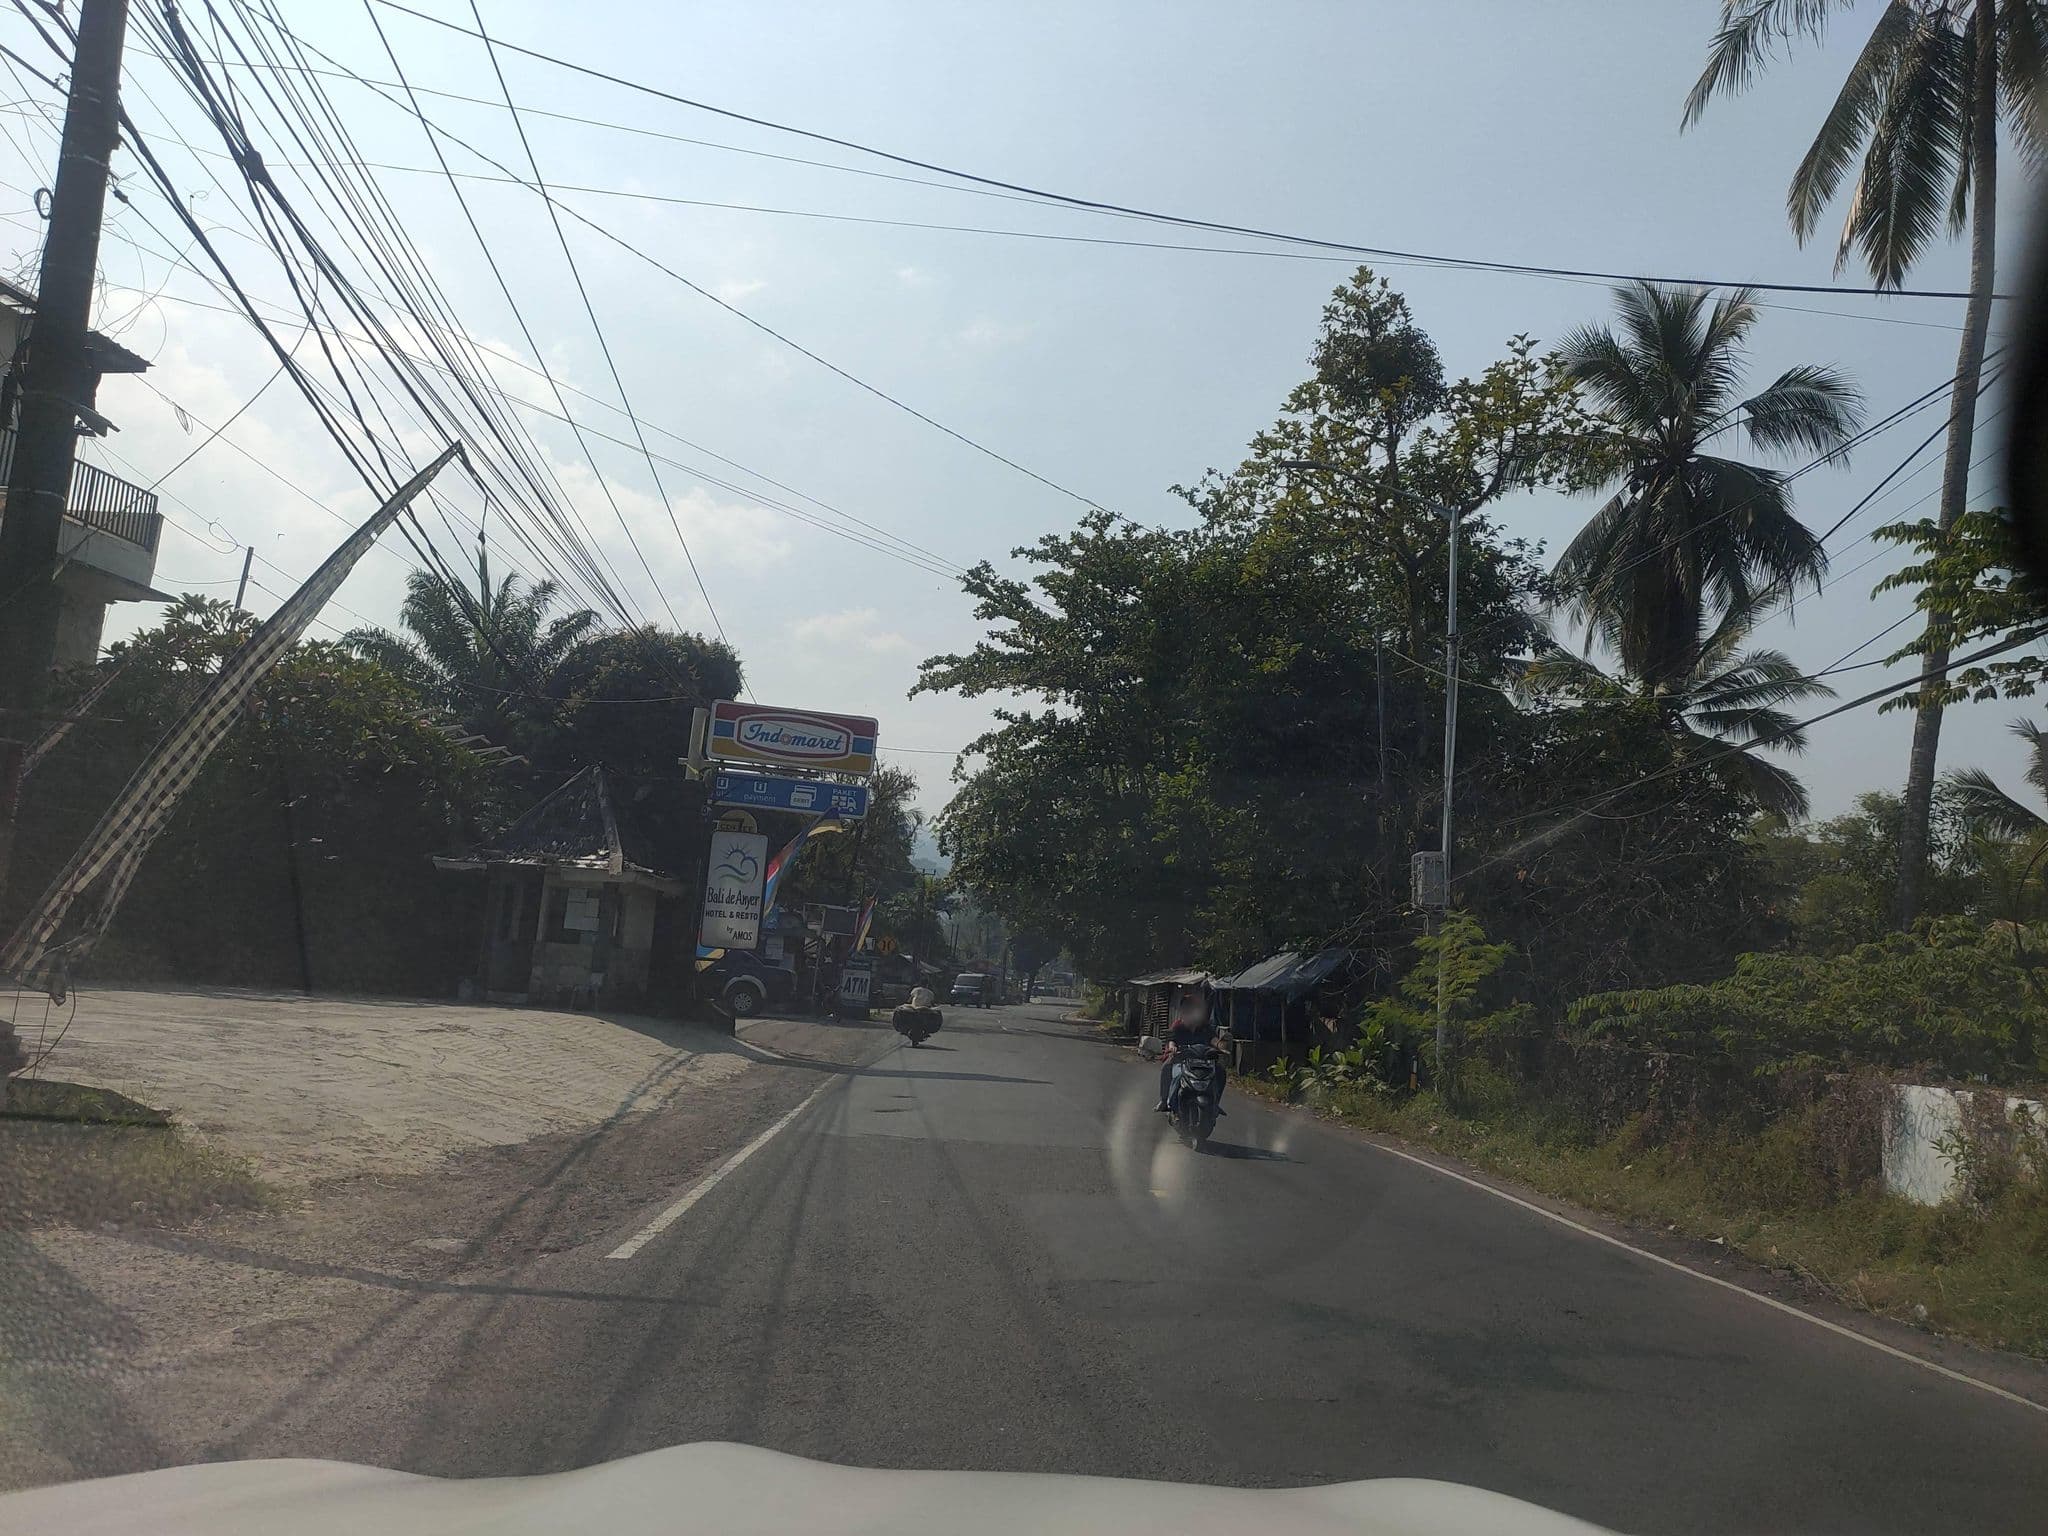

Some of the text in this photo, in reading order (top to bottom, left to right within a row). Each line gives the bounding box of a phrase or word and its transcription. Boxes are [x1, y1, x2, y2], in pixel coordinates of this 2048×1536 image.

[743, 723, 842, 751] Indomaret
[832, 788, 857, 797] PAKET
[707, 886, 760, 910] Bali de Anyer
[705, 909, 759, 920] HOTEL & RESTO
[732, 930, 753, 941] AMOS
[842, 976, 869, 993] ATM
